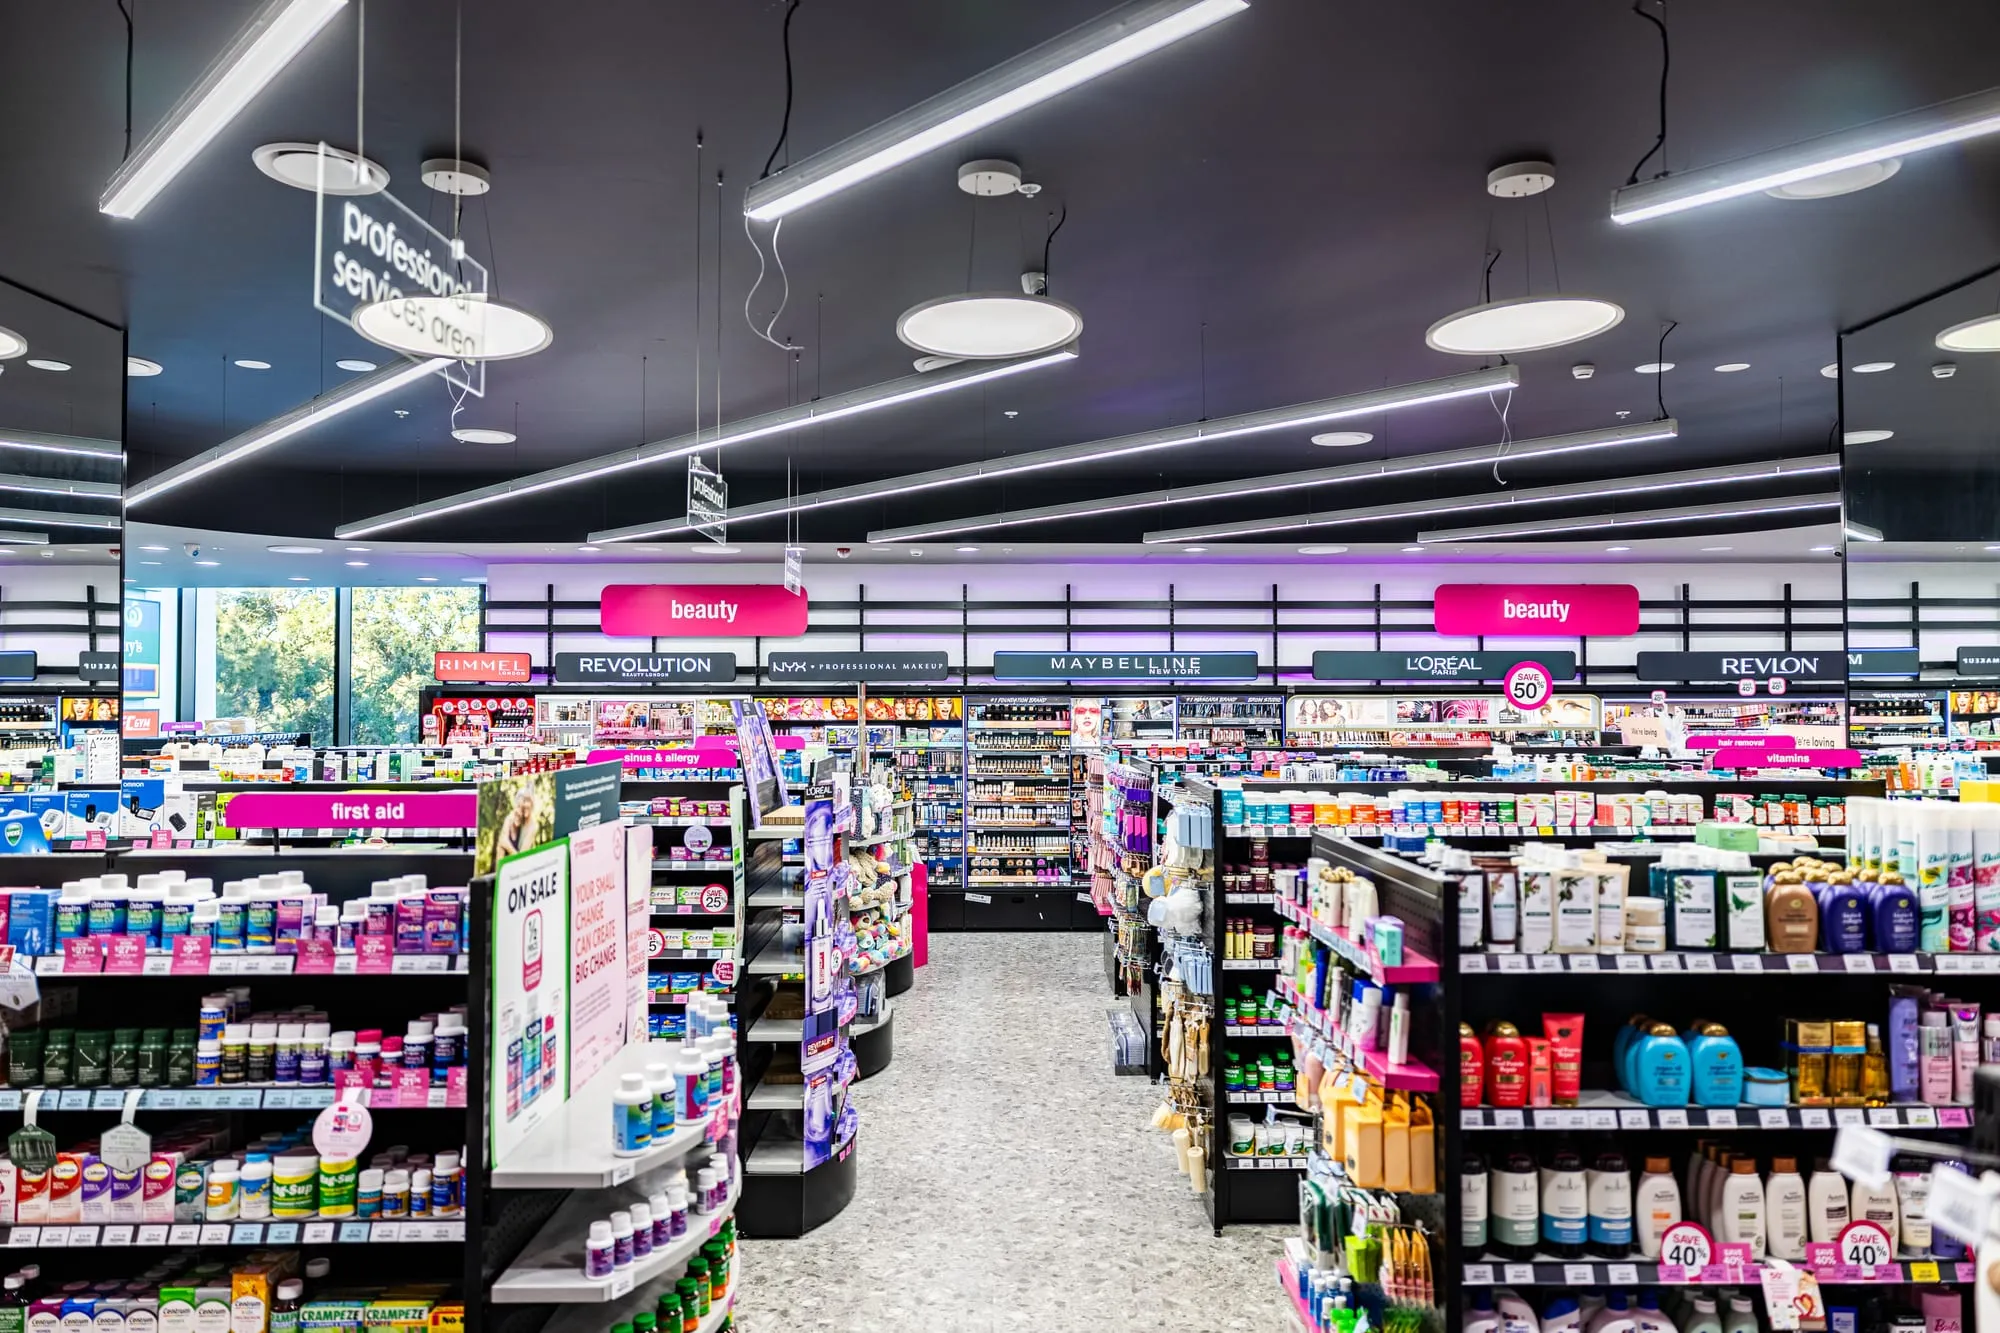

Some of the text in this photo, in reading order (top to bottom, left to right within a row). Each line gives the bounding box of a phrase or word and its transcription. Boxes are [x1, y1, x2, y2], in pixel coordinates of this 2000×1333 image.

[342, 200, 474, 316] professional
[332, 250, 477, 367] services area
[671, 600, 738, 623] beauty
[1503, 599, 1570, 623] beauty
[439, 659, 524, 671] RIMMEL
[579, 657, 712, 673] REVOLUTION
[773, 661, 807, 672] NYX
[1051, 657, 1202, 670] MAYBELLINE
[1406, 656, 1482, 671] L'ORÉAL
[1721, 657, 1819, 674] REVLON
[1517, 673, 1540, 682] SAVE
[135, 718, 150, 728] GYM
[1718, 739, 1765, 747] hair removal
[1811, 736, 1835, 749] loving
[624, 753, 700, 766] sinus & allergy
[1767, 753, 1810, 764] vitamins
[331, 801, 405, 820] first aid
[508, 871, 557, 914] ON SALE
[575, 874, 616, 903] YOUR SMALL
[707, 889, 722, 897] SAVE
[576, 901, 604, 931] CHANGE
[575, 919, 616, 958] CAN CREATE
[575, 942, 617, 985] BIG CHANGE
[808, 1035, 834, 1051] REVITALIFT
[1672, 1234, 1701, 1245] SAVE
[1851, 1234, 1879, 1244] SAVE
[1724, 1248, 1743, 1256] SAVE
[1815, 1248, 1834, 1256] SAVE
[1723, 1256, 1745, 1266] 40%
[1814, 1256, 1836, 1266] 40%
[162, 1307, 191, 1315] Centrum
[198, 1307, 226, 1316] Centrum
[301, 1310, 359, 1321] CRAMPEZE
[366, 1309, 424, 1320] CRAMPEZE
